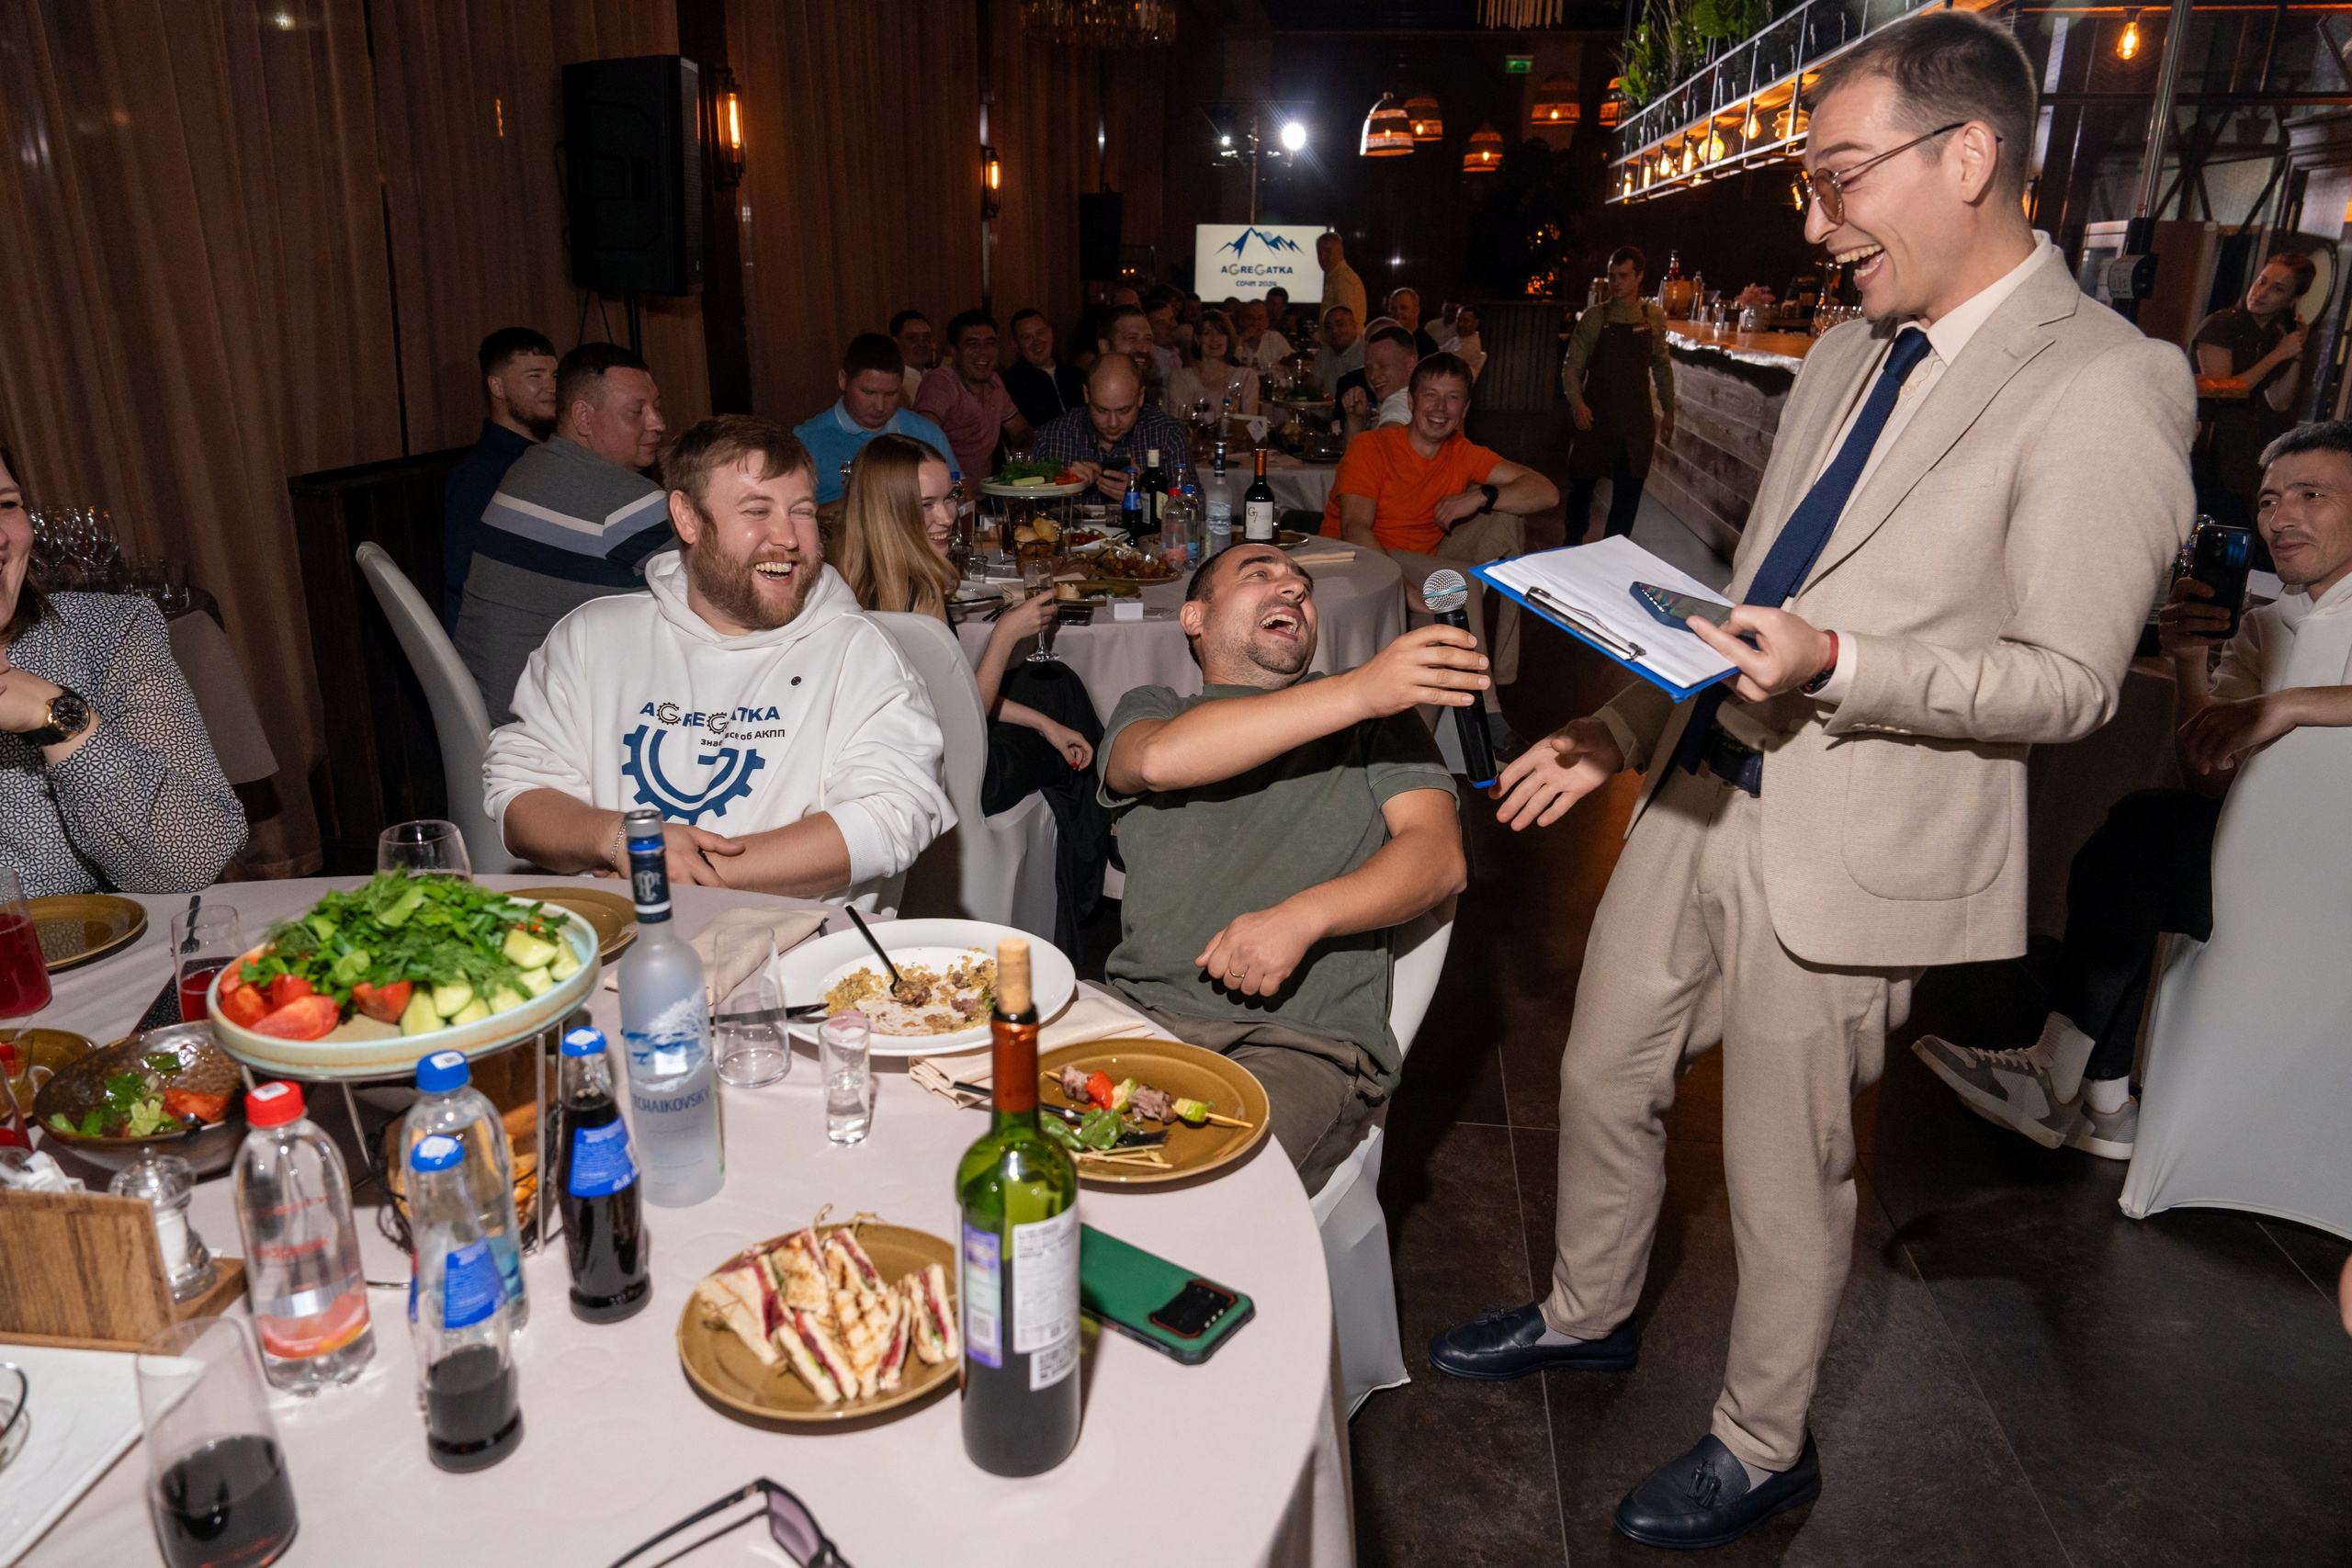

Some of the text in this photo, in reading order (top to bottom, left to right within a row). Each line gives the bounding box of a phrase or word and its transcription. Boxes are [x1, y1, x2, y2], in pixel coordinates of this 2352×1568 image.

[1221, 264, 1294, 276] AGREGATKA
[740, 731, 752, 740] об
[754, 729, 786, 739] АКПП
